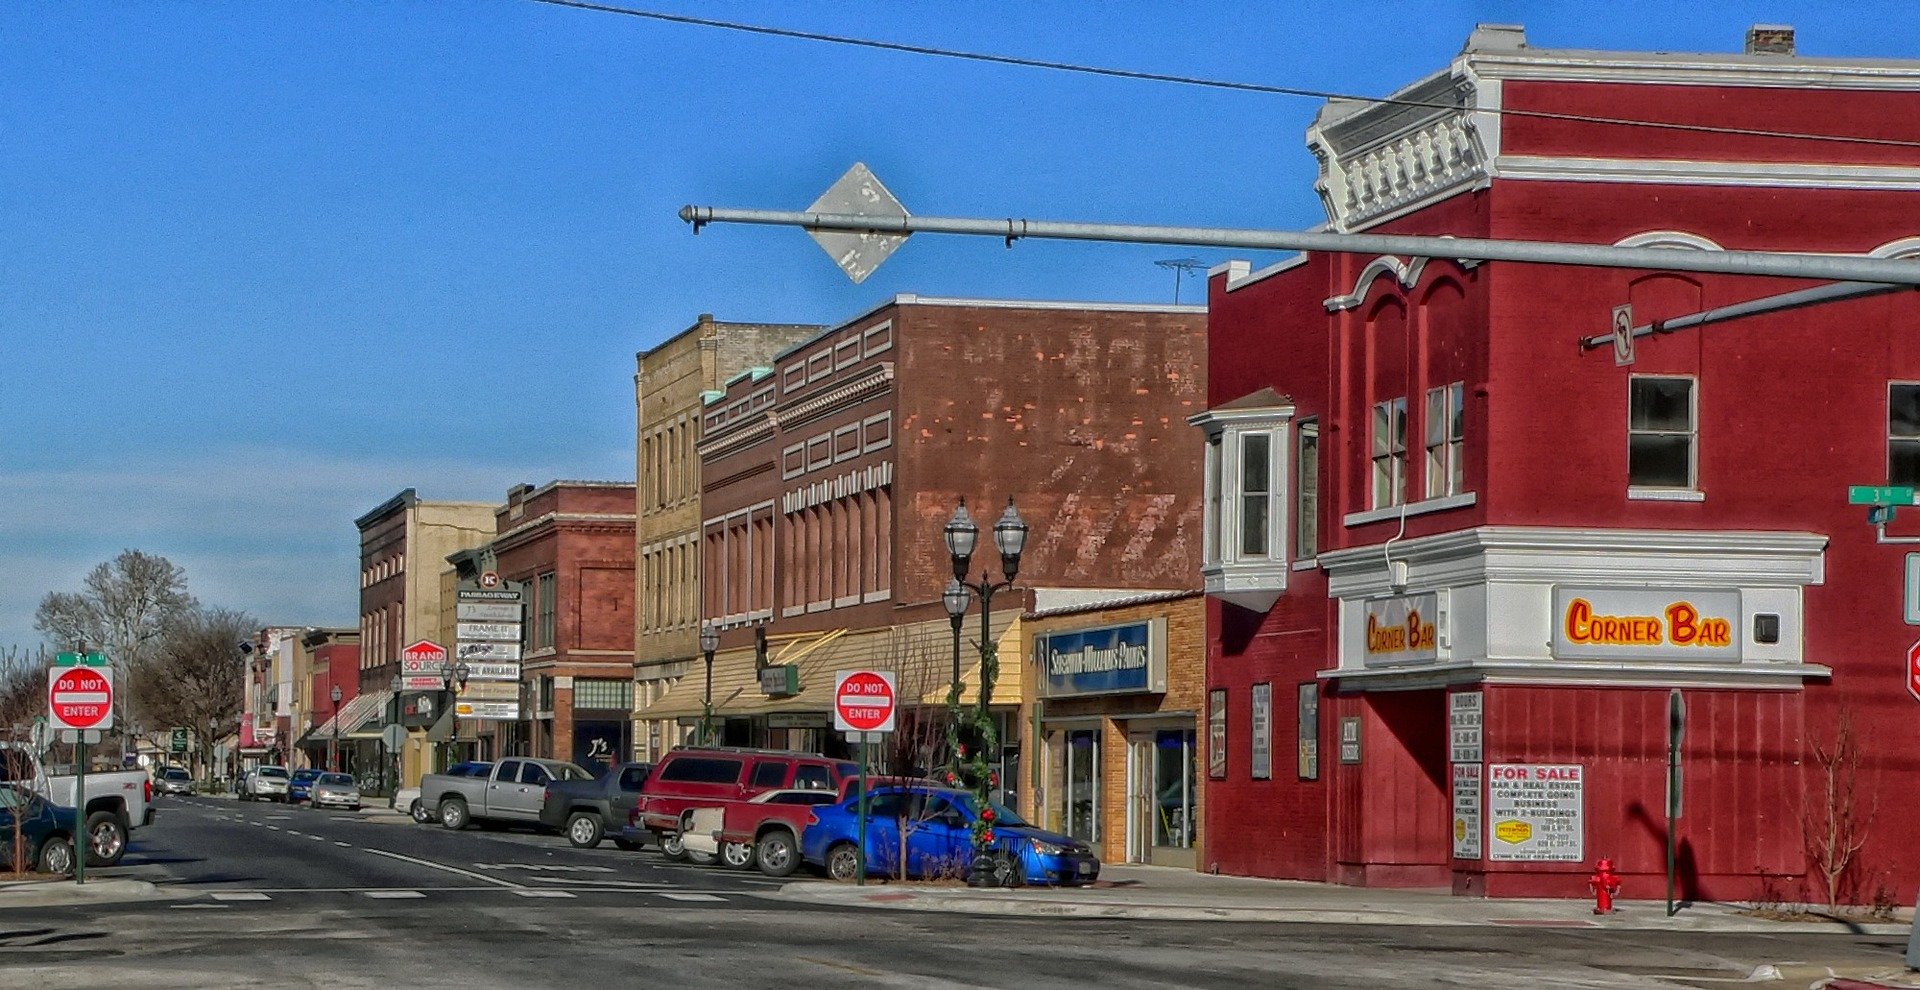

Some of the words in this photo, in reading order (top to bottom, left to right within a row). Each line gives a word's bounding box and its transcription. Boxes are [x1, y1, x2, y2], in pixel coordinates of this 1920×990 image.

[405, 651, 444, 660] BRAND
[404, 661, 444, 671] SOURC
[59, 679, 75, 690] DO
[80, 680, 103, 690] NOT
[846, 682, 861, 693] DO
[864, 683, 884, 693] NOT
[63, 706, 99, 717] ENTER
[849, 708, 880, 719] ENTER
[1494, 767, 1528, 780] FOR
[1535, 768, 1580, 780] SALE
[1491, 781, 1510, 789] BAR
[1548, 782, 1581, 790] ESTATE
[1497, 790, 1544, 799] COMPLETE
[1546, 791, 1576, 799] GOING
[1514, 800, 1558, 808] BUSINESS
[1496, 809, 1518, 817] WITH
[1520, 809, 1578, 818] 2-BUILDINGS
